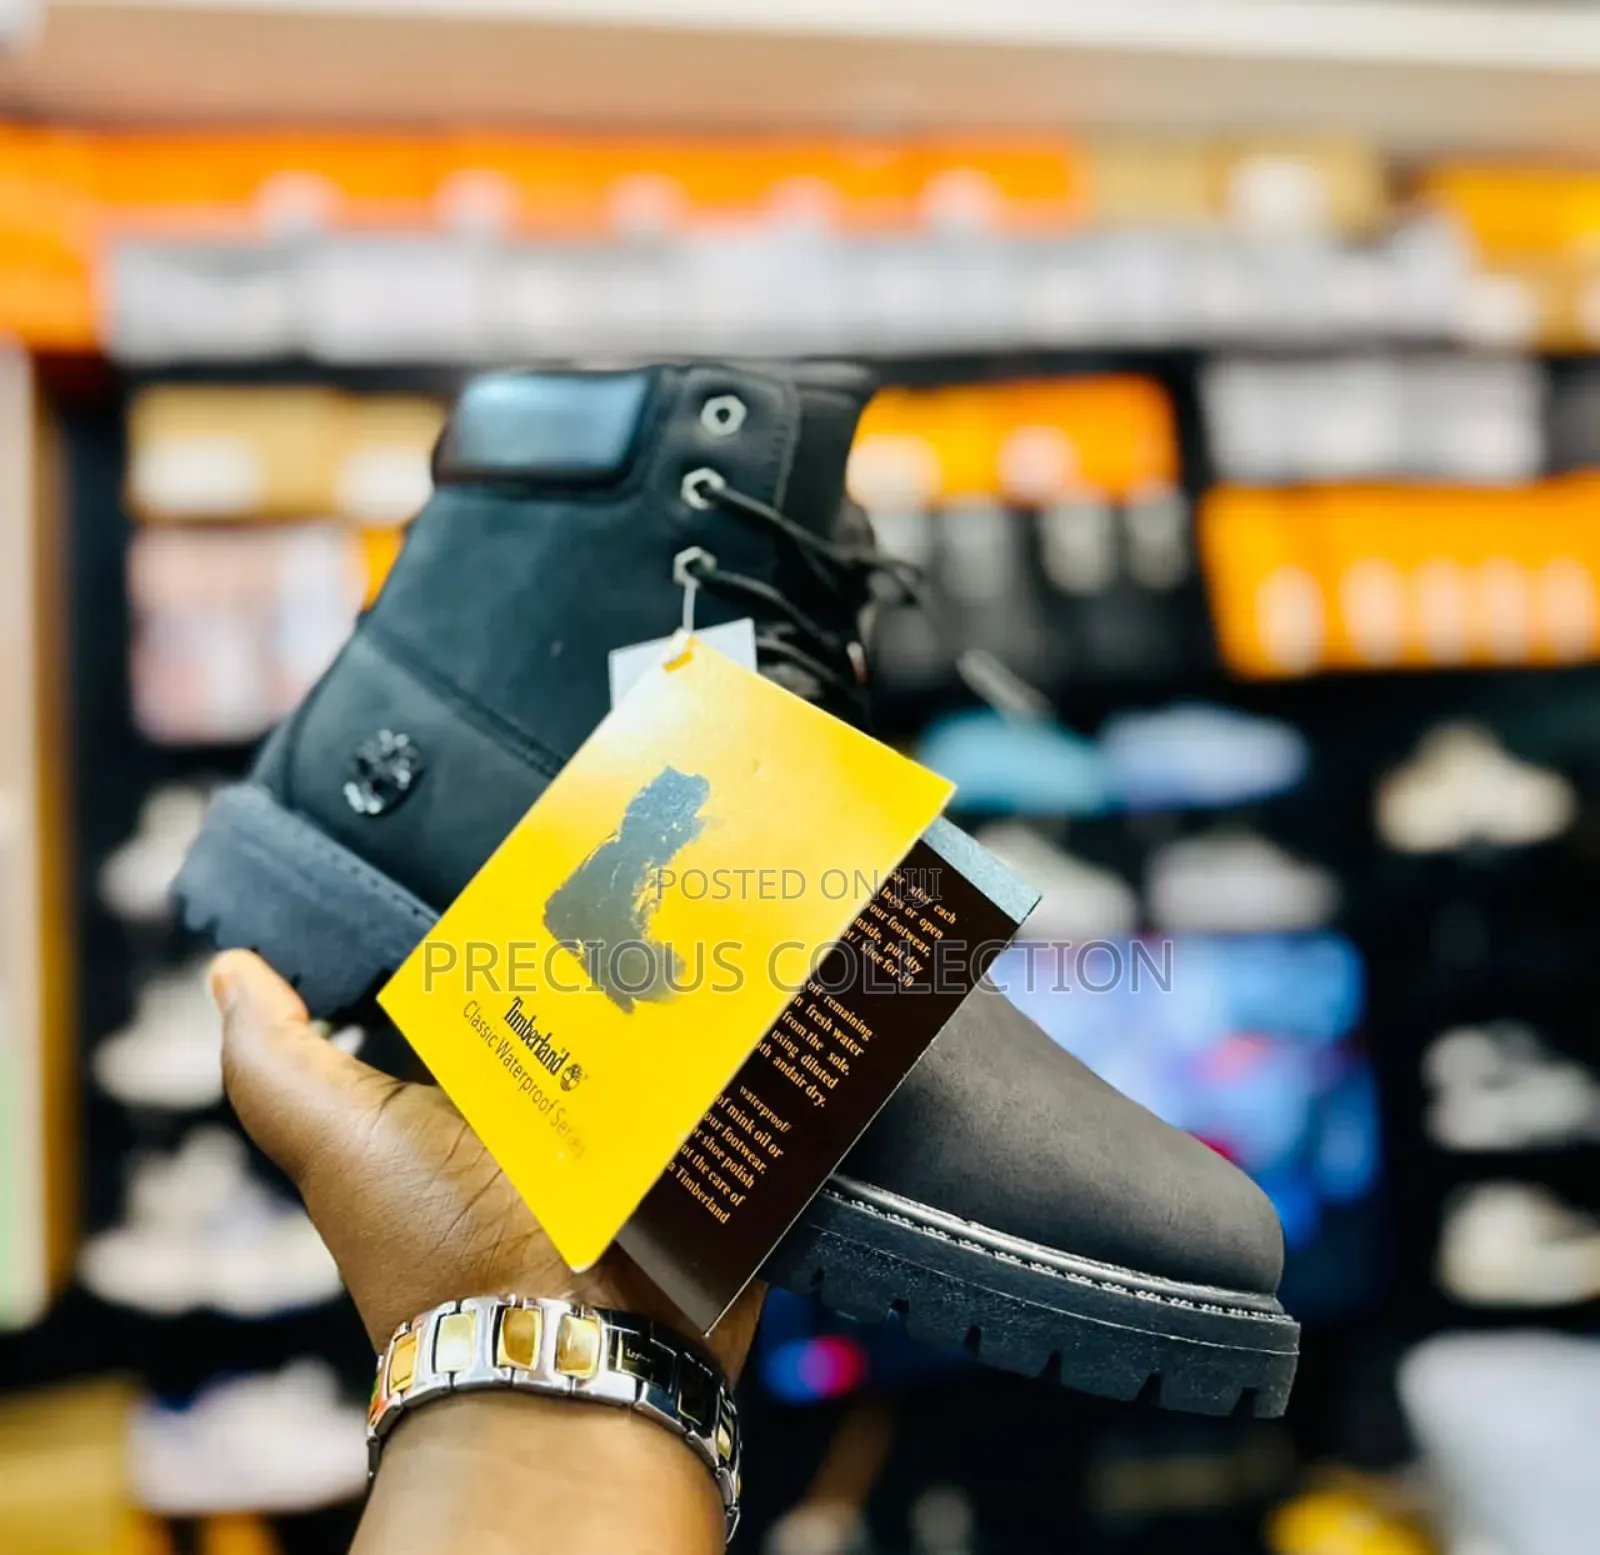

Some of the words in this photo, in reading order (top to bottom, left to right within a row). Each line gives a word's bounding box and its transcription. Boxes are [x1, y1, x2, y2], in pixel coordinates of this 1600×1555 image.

[867, 903, 889, 921] our
[904, 907, 919, 919] or
[919, 918, 944, 940] open
[934, 904, 957, 925] each
[882, 959, 901, 976] for
[805, 1003, 833, 1031] fresh
[833, 1027, 865, 1057] water
[805, 1032, 825, 1051] the
[823, 994, 873, 1042] remaining
[462, 999, 499, 1048] Classic
[494, 1037, 560, 1117] Waterproof
[771, 1029, 800, 1059] using
[800, 1053, 840, 1090] diluted
[702, 1111, 725, 1131] our
[726, 1104, 756, 1135] mink
[753, 1131, 773, 1148] oil
[767, 1143, 785, 1158] or
[692, 1154, 710, 1175] the
[708, 1170, 731, 1196] care
[729, 1191, 747, 1207] of
[701, 1135, 726, 1160] shoe
[721, 1156, 755, 1190] polish
[675, 1164, 731, 1225] Timberland
